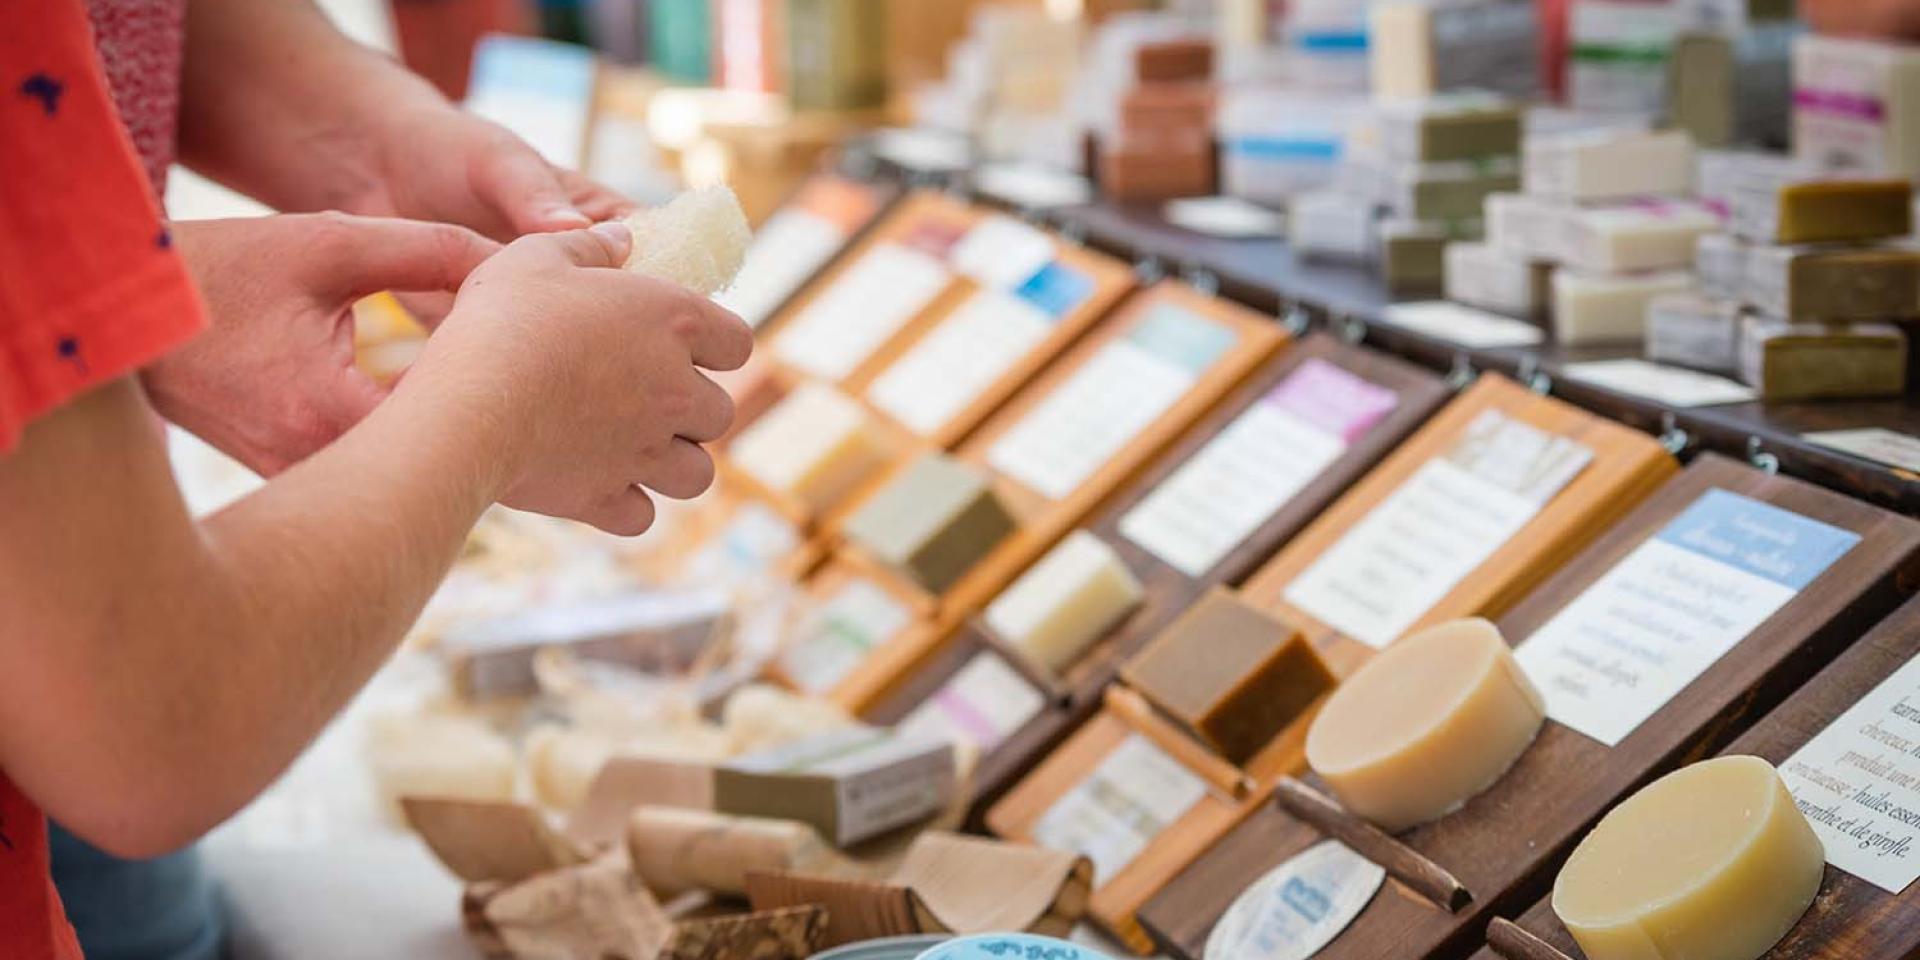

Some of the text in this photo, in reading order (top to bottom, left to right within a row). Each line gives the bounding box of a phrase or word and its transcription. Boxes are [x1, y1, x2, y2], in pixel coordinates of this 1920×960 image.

[1834, 750, 1894, 778] produit
[1886, 769, 1916, 788] une
[1797, 799, 1842, 827] menthe
[1836, 818, 1859, 833] et
[1849, 820, 1873, 841] de
[1851, 783, 1893, 814] huiles
[1888, 806, 1920, 830] essen
